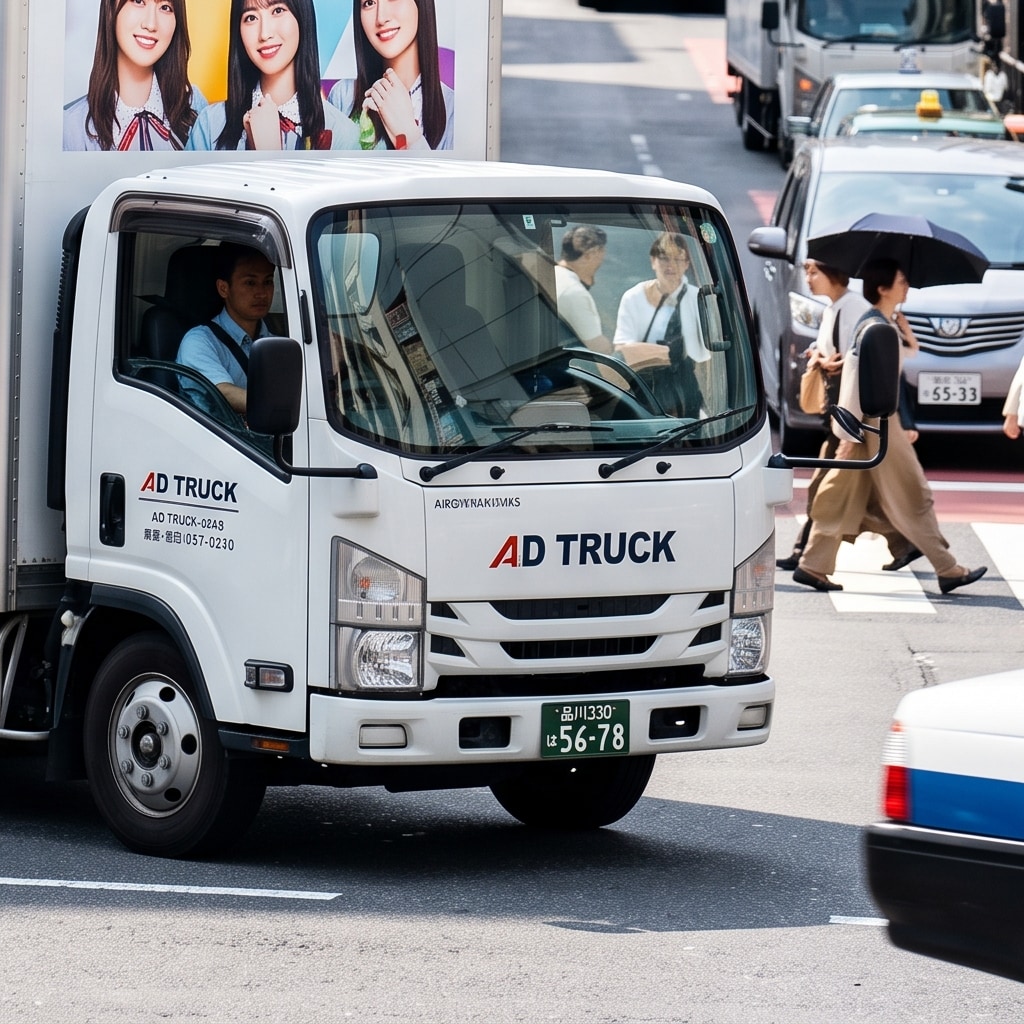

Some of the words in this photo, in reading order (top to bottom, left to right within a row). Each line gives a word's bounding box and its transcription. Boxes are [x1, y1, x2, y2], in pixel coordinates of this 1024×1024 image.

[140, 471, 169, 494] AD
[173, 474, 238, 503] TRUCK
[488, 534, 546, 569] AD
[555, 530, 677, 566] TRUCK
[560, 704, 613, 722] 品川330
[560, 723, 625, 753] 56-78
